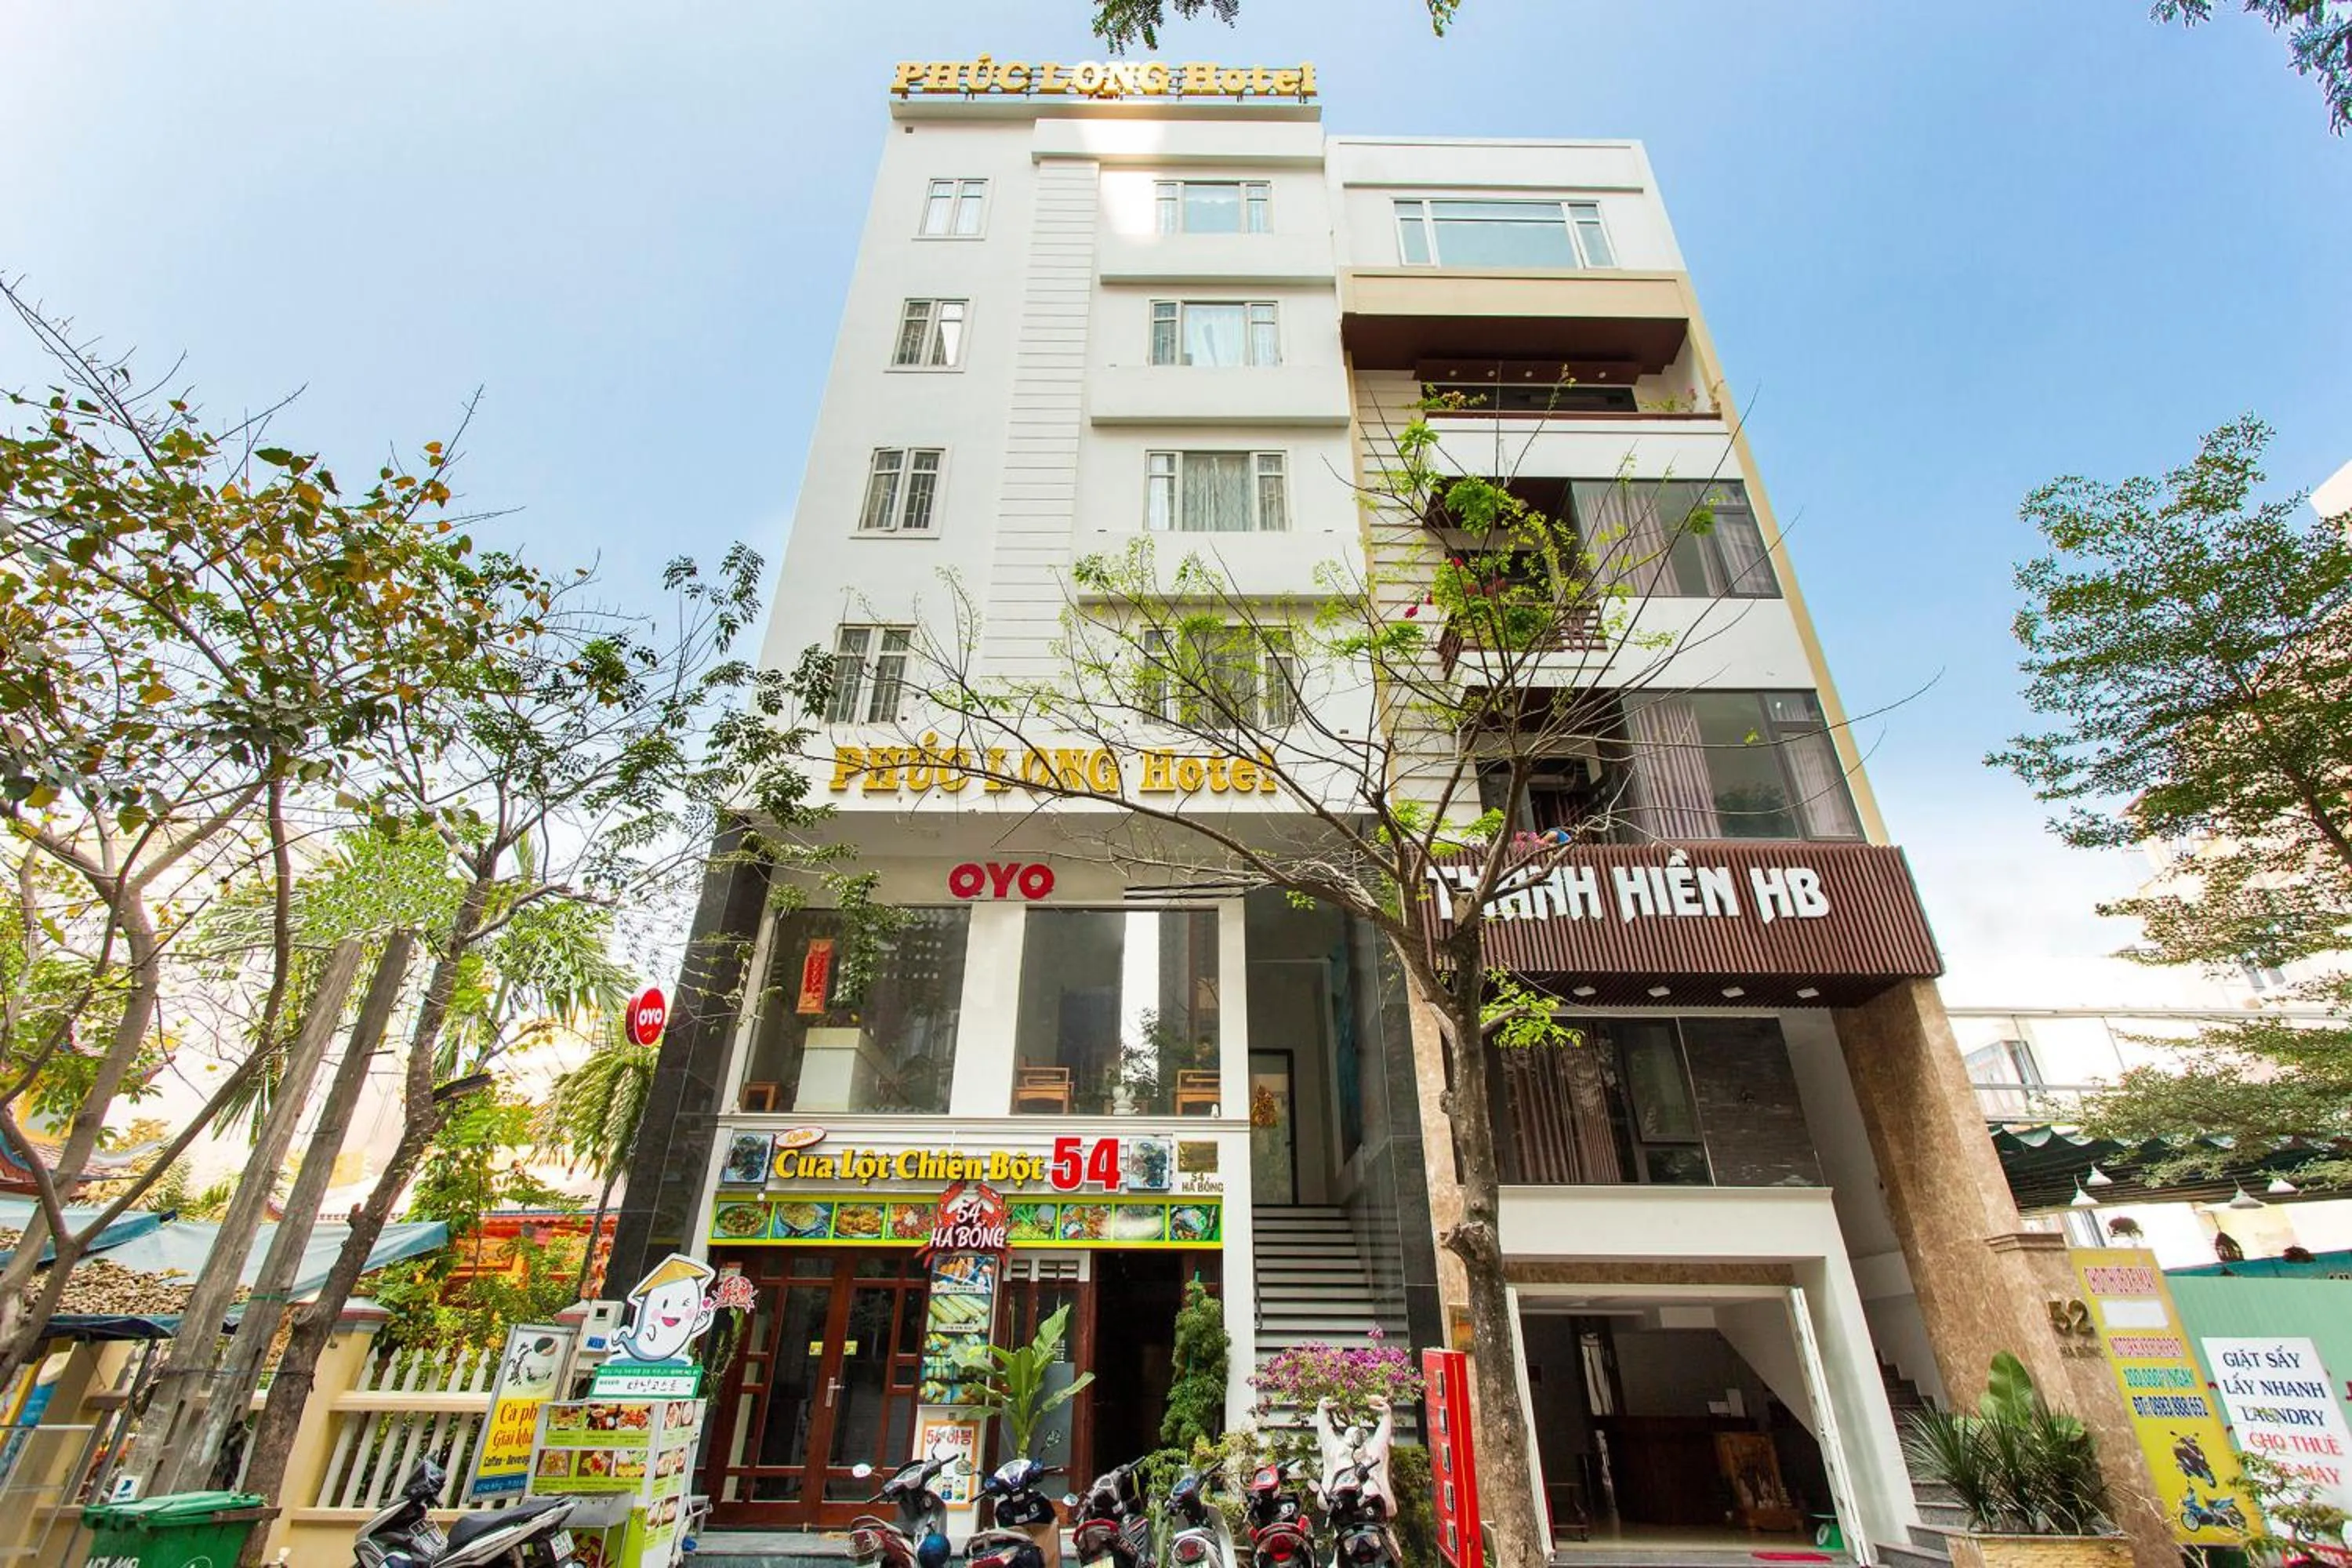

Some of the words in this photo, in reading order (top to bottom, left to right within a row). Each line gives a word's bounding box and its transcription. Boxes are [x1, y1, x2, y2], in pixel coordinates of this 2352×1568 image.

[891, 52, 1030, 94] PHÚC
[1039, 60, 1170, 96] LONG
[1180, 60, 1318, 96] Hotel
[829, 731, 971, 792] PHÚC
[984, 746, 1120, 793] LONG
[1139, 746, 1277, 793] Hotel
[947, 862, 1055, 900] OYO
[1749, 867, 1831, 924] HB
[638, 1007, 663, 1026] OYO
[840, 1148, 892, 1187] Lột
[989, 1147, 1045, 1189] Bột
[1050, 1136, 1123, 1192] 54
[956, 1202, 982, 1224] 54
[2048, 1299, 2096, 1335] 52
[2259, 1380, 2328, 1399] NHANH
[518, 1401, 537, 1427] ph
